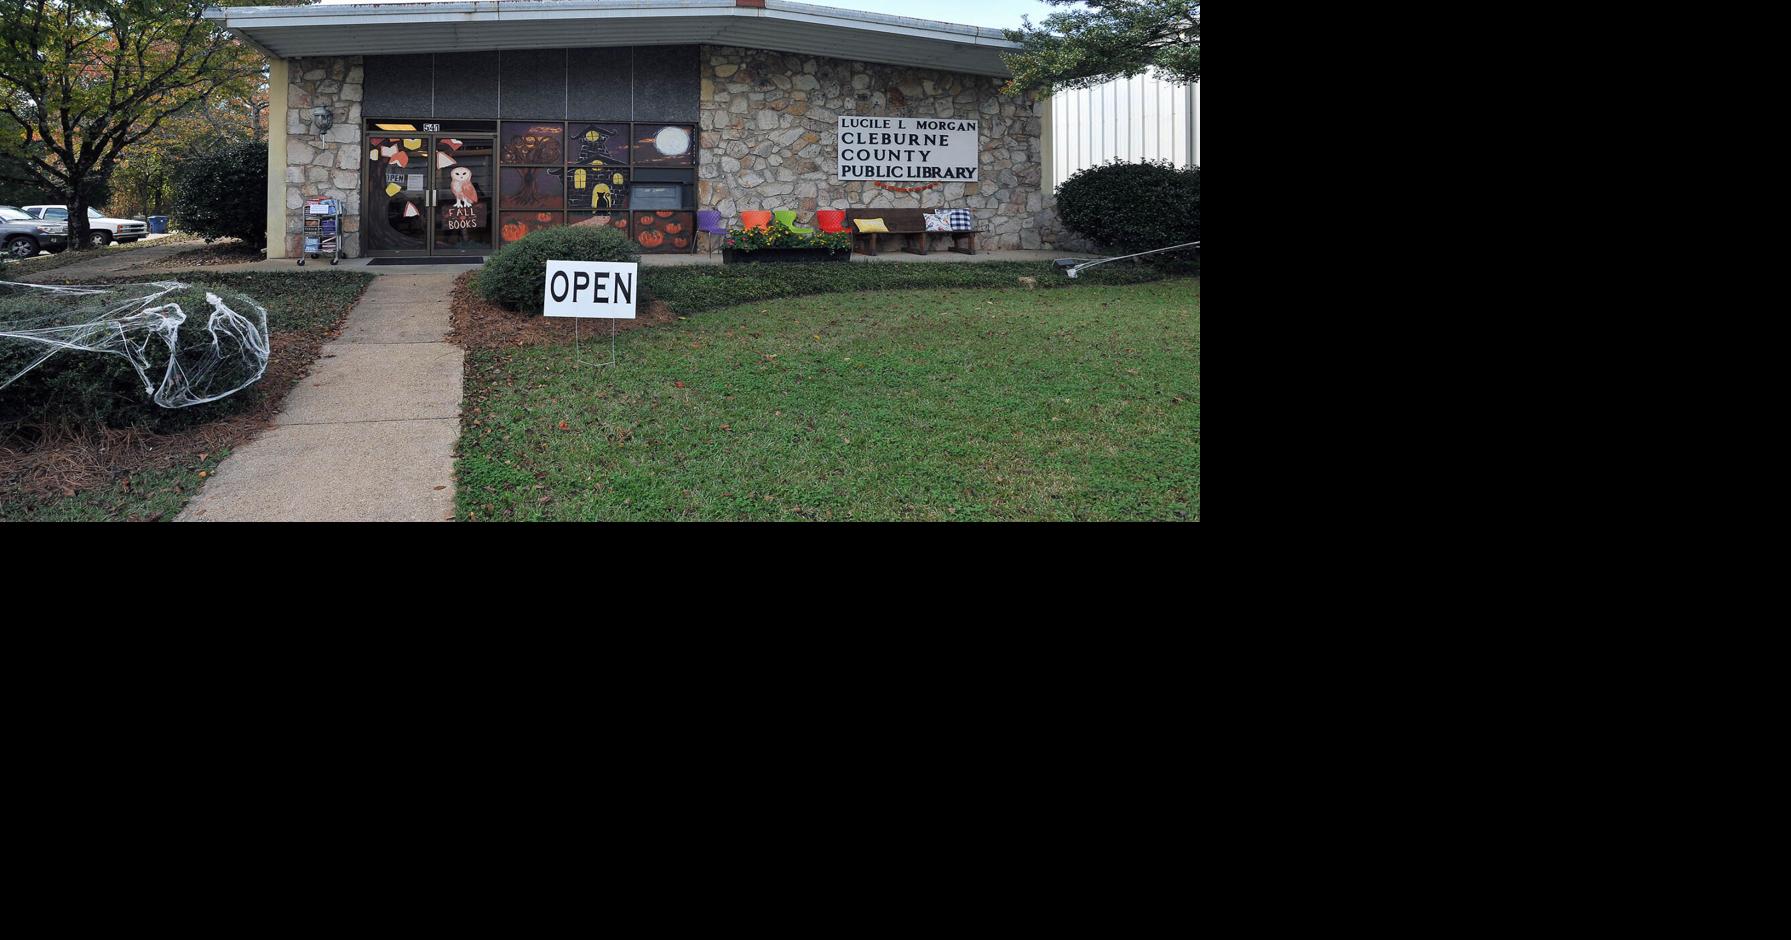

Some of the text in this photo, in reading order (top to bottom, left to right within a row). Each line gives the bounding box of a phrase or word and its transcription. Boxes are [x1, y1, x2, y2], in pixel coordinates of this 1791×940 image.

[841, 118, 976, 131] LUCILE L MORGAN
[841, 132, 949, 146] CLEBURNE
[841, 149, 931, 162] COUNTY
[841, 165, 977, 179] PUBLIC LIBRARY
[448, 208, 476, 217] FALL
[448, 219, 477, 230] BOOKS
[550, 270, 632, 304] OPEN
